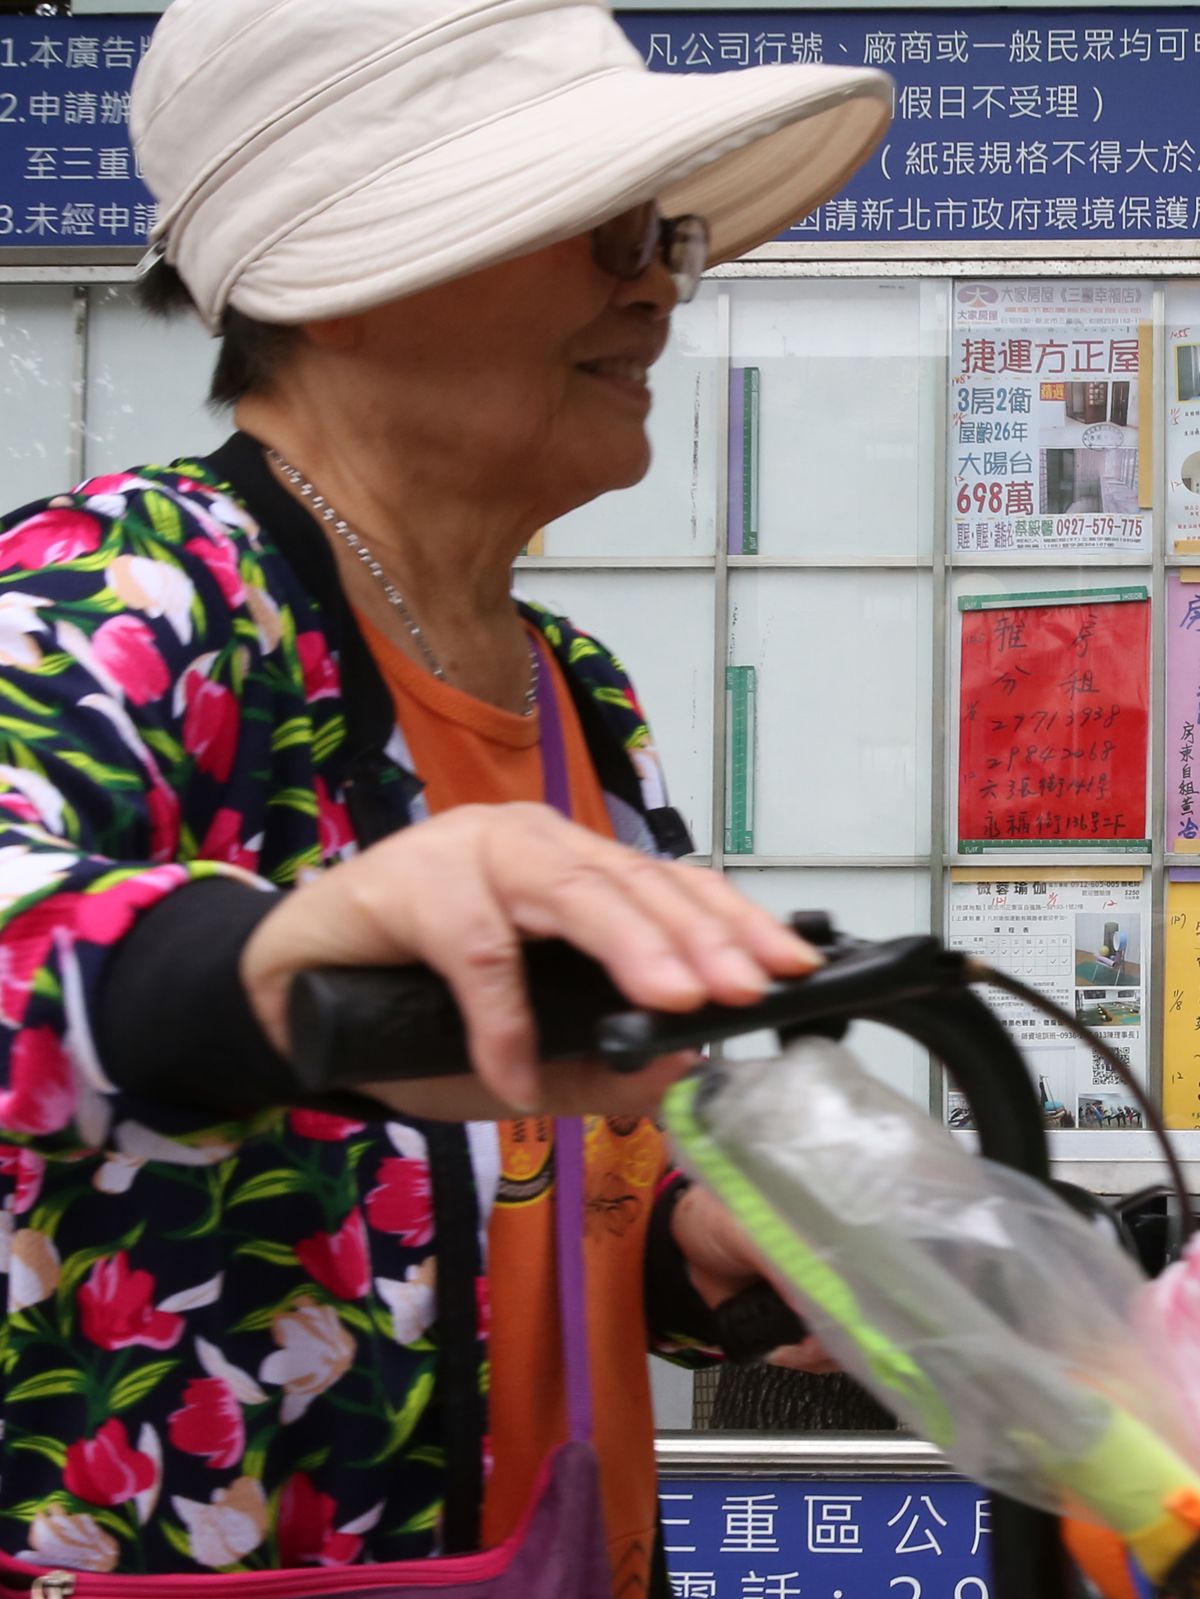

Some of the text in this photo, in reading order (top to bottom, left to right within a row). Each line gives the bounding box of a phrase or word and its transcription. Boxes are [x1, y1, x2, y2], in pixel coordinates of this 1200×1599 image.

[890, 85, 1103, 122] 假日不受理）
[24, 146, 142, 180] 至三重
[961, 339, 1139, 374] 捷運方正屋
[958, 387, 1032, 414] 3房2衛
[959, 421, 1028, 443] 屋齡26年
[958, 451, 1032, 475] 大陽台
[957, 481, 1034, 515] 698萬
[1056, 519, 1142, 537] 0927-579-775
[992, 666, 1100, 699] 分租
